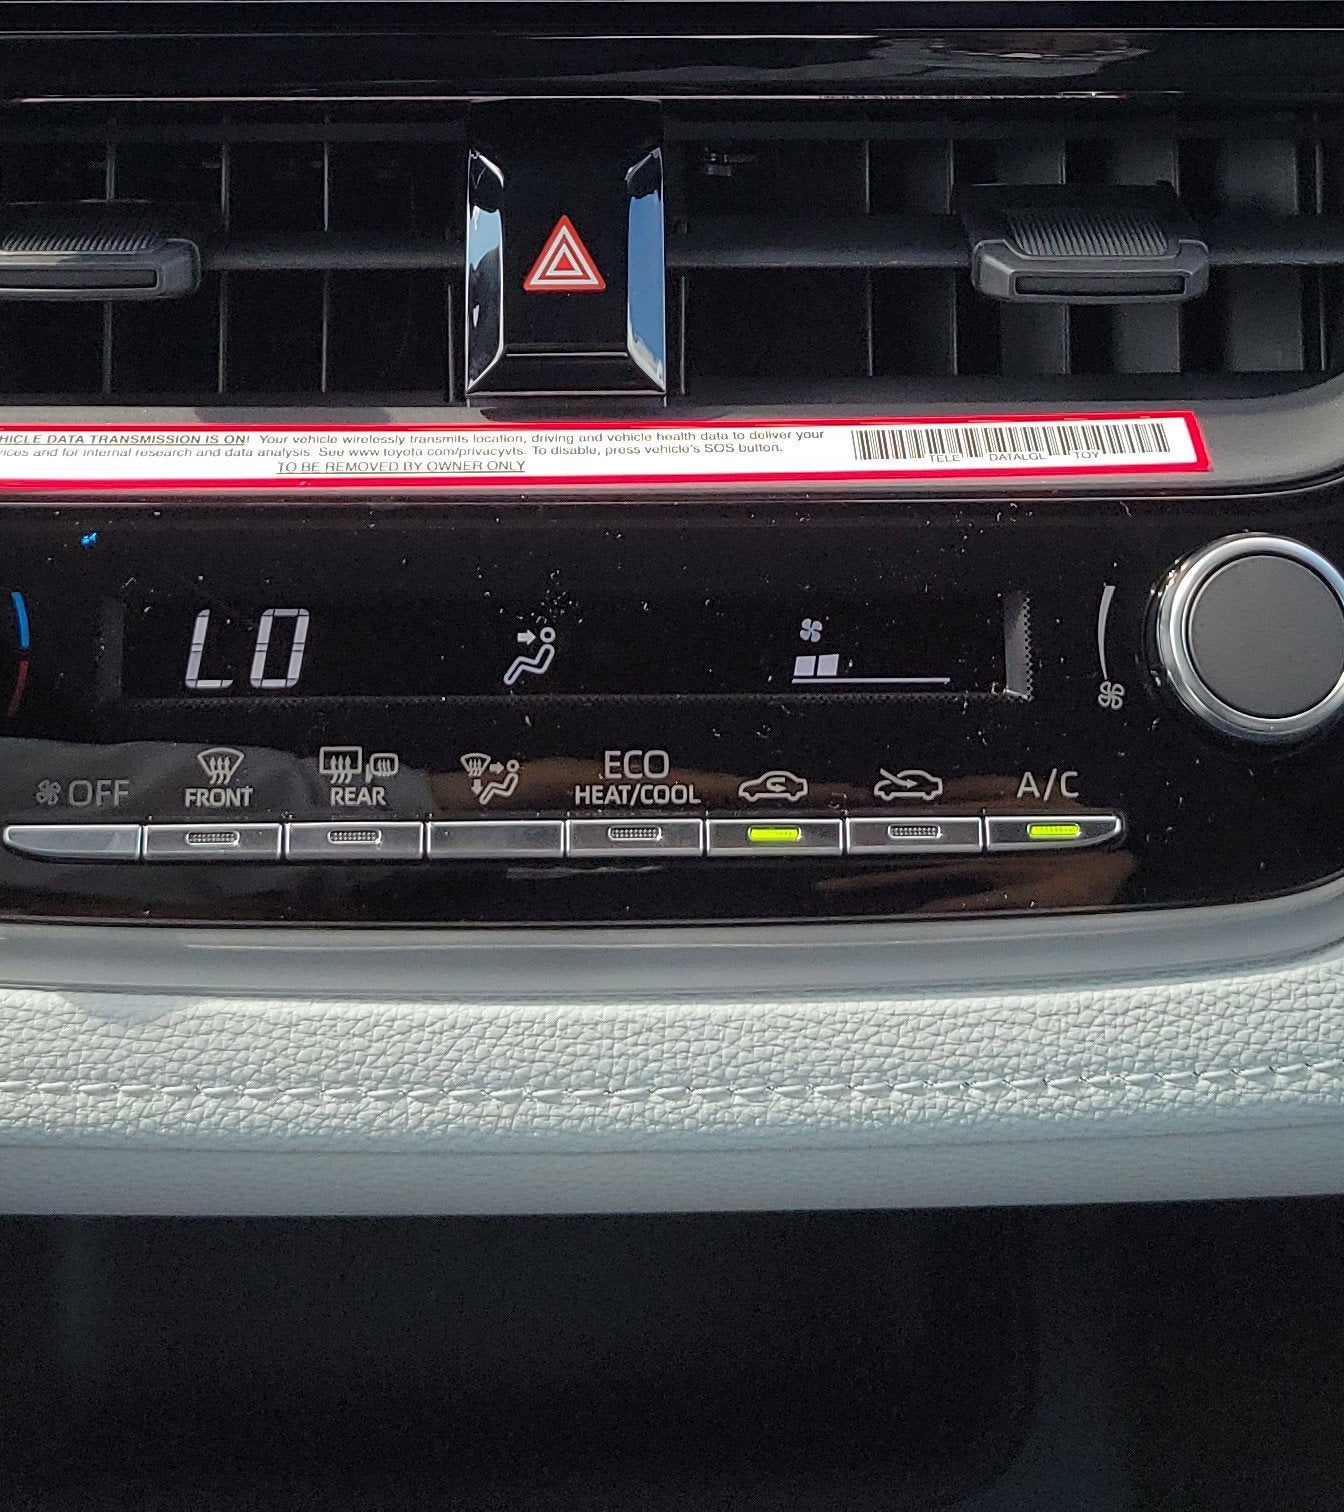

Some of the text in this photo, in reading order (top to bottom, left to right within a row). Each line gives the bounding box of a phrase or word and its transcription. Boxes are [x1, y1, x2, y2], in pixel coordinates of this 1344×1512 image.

[46, 434, 85, 444] DATA
[90, 434, 201, 444] TRANSMISSION
[205, 434, 219, 444] IS
[259, 434, 288, 444] Your
[293, 434, 338, 444] vehicle
[342, 434, 406, 445] wirelessly
[410, 434, 469, 444] transmits
[473, 434, 527, 445] location,
[531, 432, 574, 445] driving
[578, 432, 603, 443] and
[606, 432, 652, 442] vehicle
[656, 431, 696, 442] health
[700, 431, 729, 441] data
[732, 431, 746, 440] to
[749, 430, 794, 440] deliver
[797, 430, 824, 441] your
[33, 448, 59, 457] and
[62, 447, 78, 457] for
[82, 447, 131, 457] internal
[135, 447, 192, 457] research
[196, 447, 221, 457] and
[224, 447, 253, 457] data
[257, 447, 311, 458] analysis
[318, 447, 344, 457] See
[532, 445, 548, 455] To
[550, 445, 600, 456] disable,
[605, 445, 641, 456] press
[645, 444, 701, 455] vehicle's
[704, 443, 735, 453] SOS
[738, 443, 783, 452] button.
[929, 453, 961, 463] TELE
[1073, 451, 1100, 459] TOY
[278, 461, 526, 472] TO BE REMOVED BY OWNER ONLY
[185, 608, 310, 688] LO
[603, 750, 670, 779] ECO
[68, 779, 130, 808] OFF
[330, 786, 387, 806] REAR
[574, 784, 701, 806] HEAT/COOL
[1016, 770, 1079, 801] A/C
[184, 786, 254, 807] FRONT
